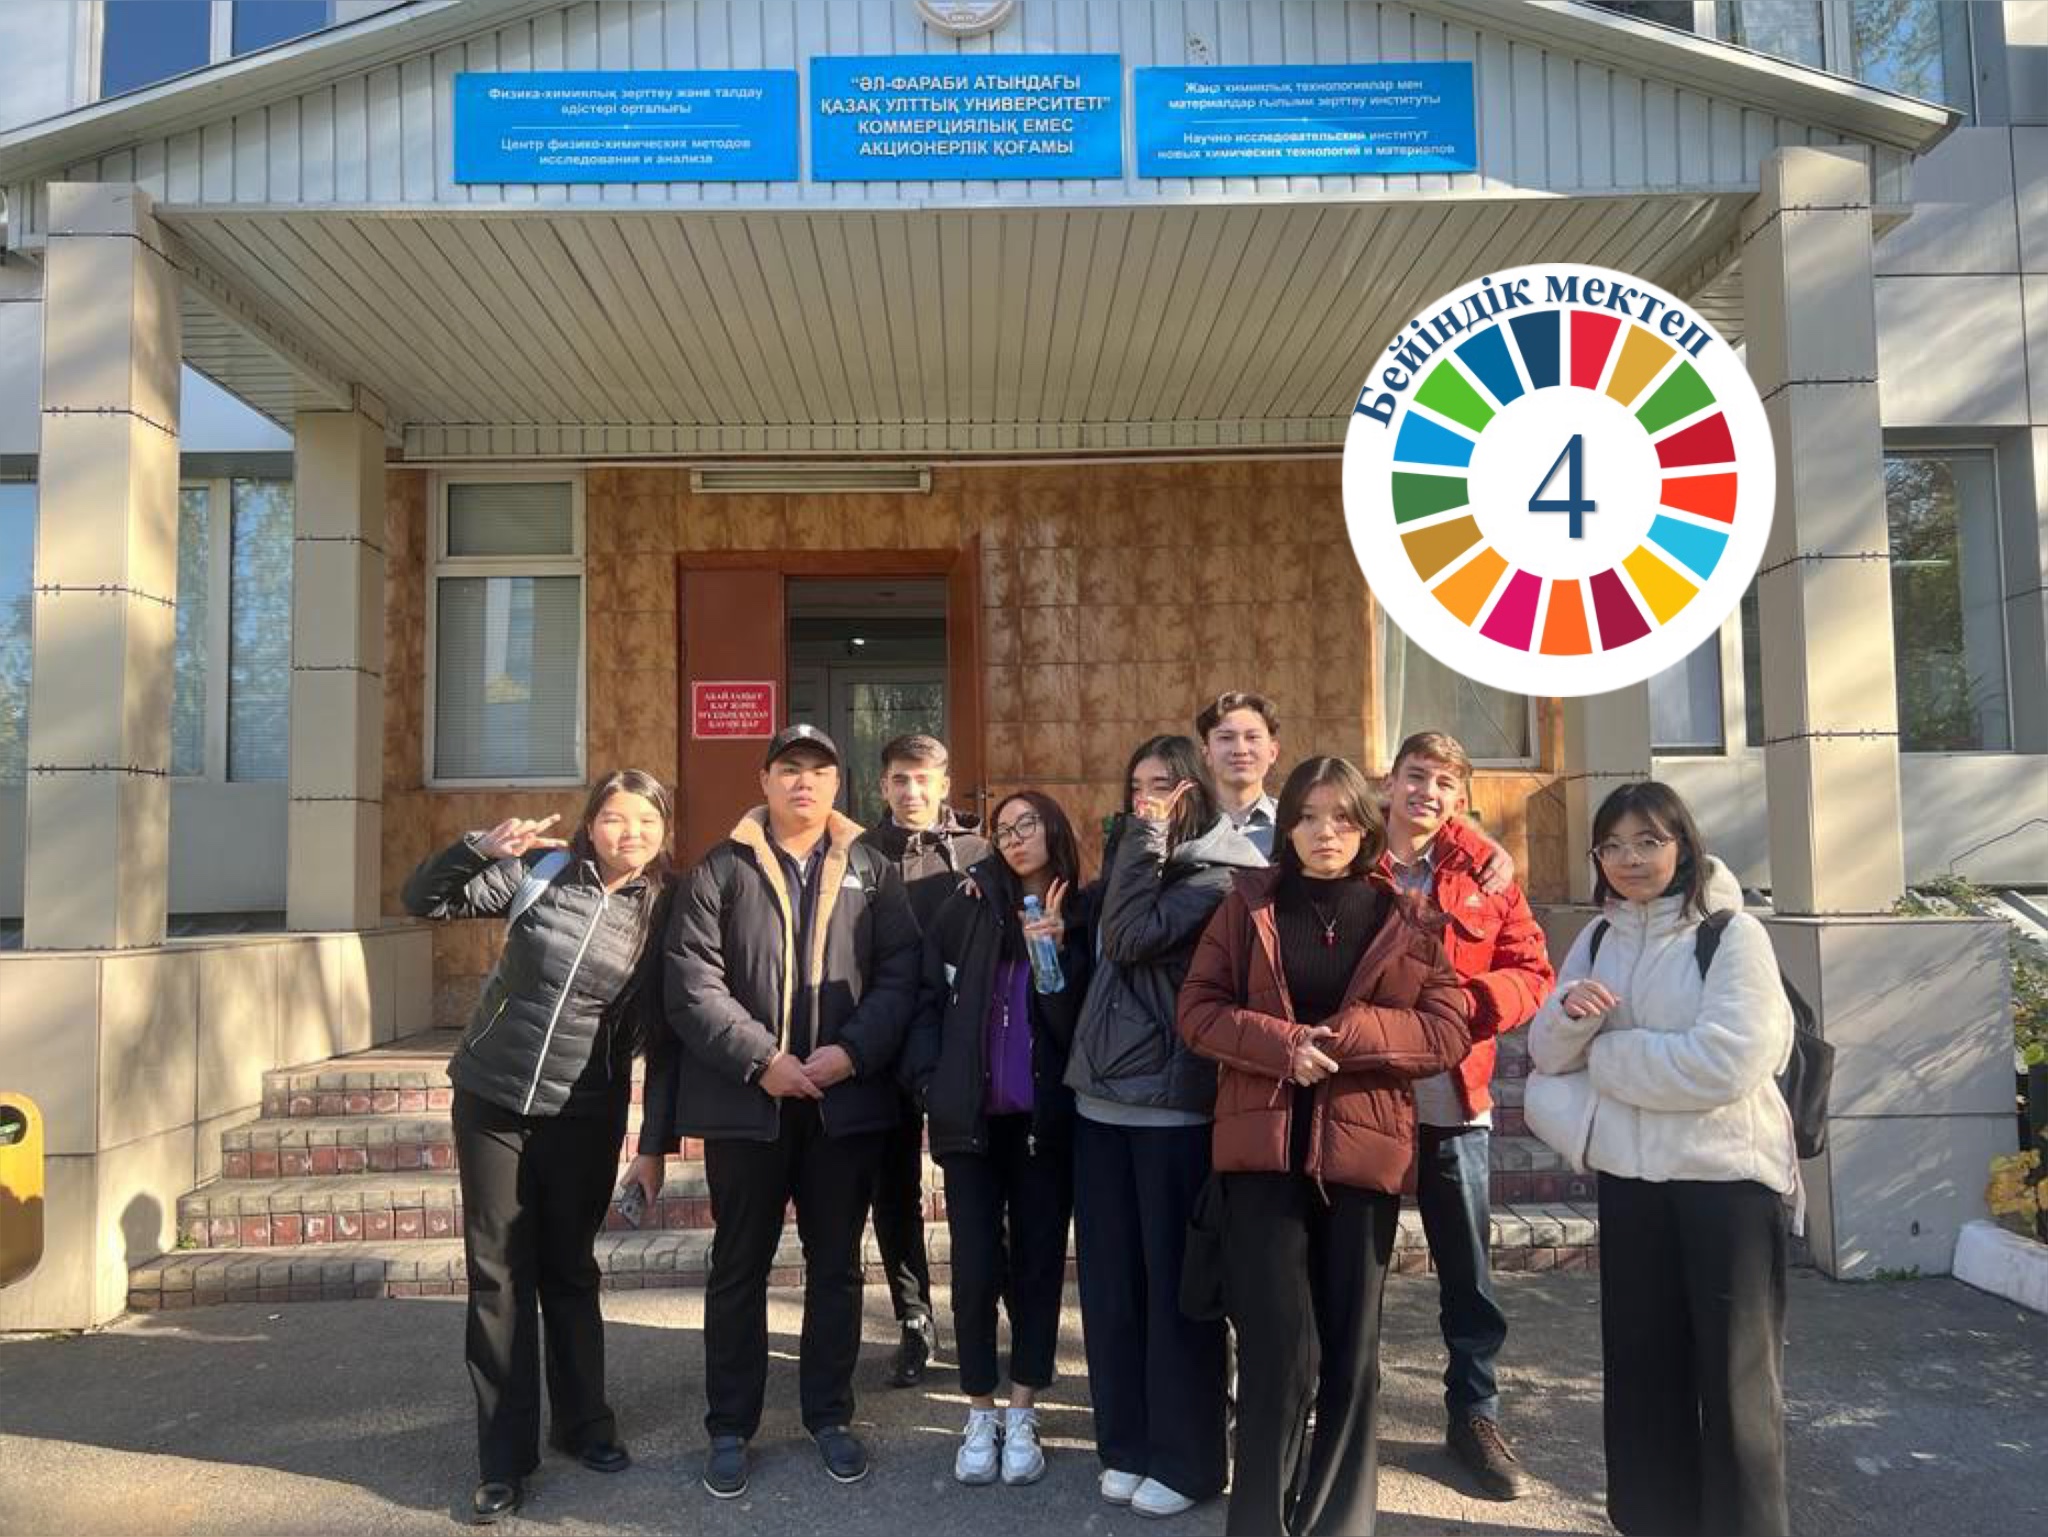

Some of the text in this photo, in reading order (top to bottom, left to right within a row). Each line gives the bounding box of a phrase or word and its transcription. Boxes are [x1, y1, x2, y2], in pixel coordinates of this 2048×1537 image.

[1397, 80, 1423, 90] мен
[623, 88, 673, 101] зерттеу
[715, 88, 763, 100] талдау
[1369, 96, 1441, 107] институты
[821, 98, 881, 115] ҚАЗАҚ
[857, 118, 1074, 135] КОММЕРЦИЯЛЫҚ ЕМЕС
[501, 138, 544, 152] Центр
[691, 139, 751, 150] методов
[1183, 132, 1232, 145] Научно
[1370, 131, 1429, 142] институт
[860, 140, 988, 157] АКЦИОНЕРЛІК
[1157, 144, 1456, 159] новых химических технологий и материалов
[540, 154, 713, 165] исследования и анализа
